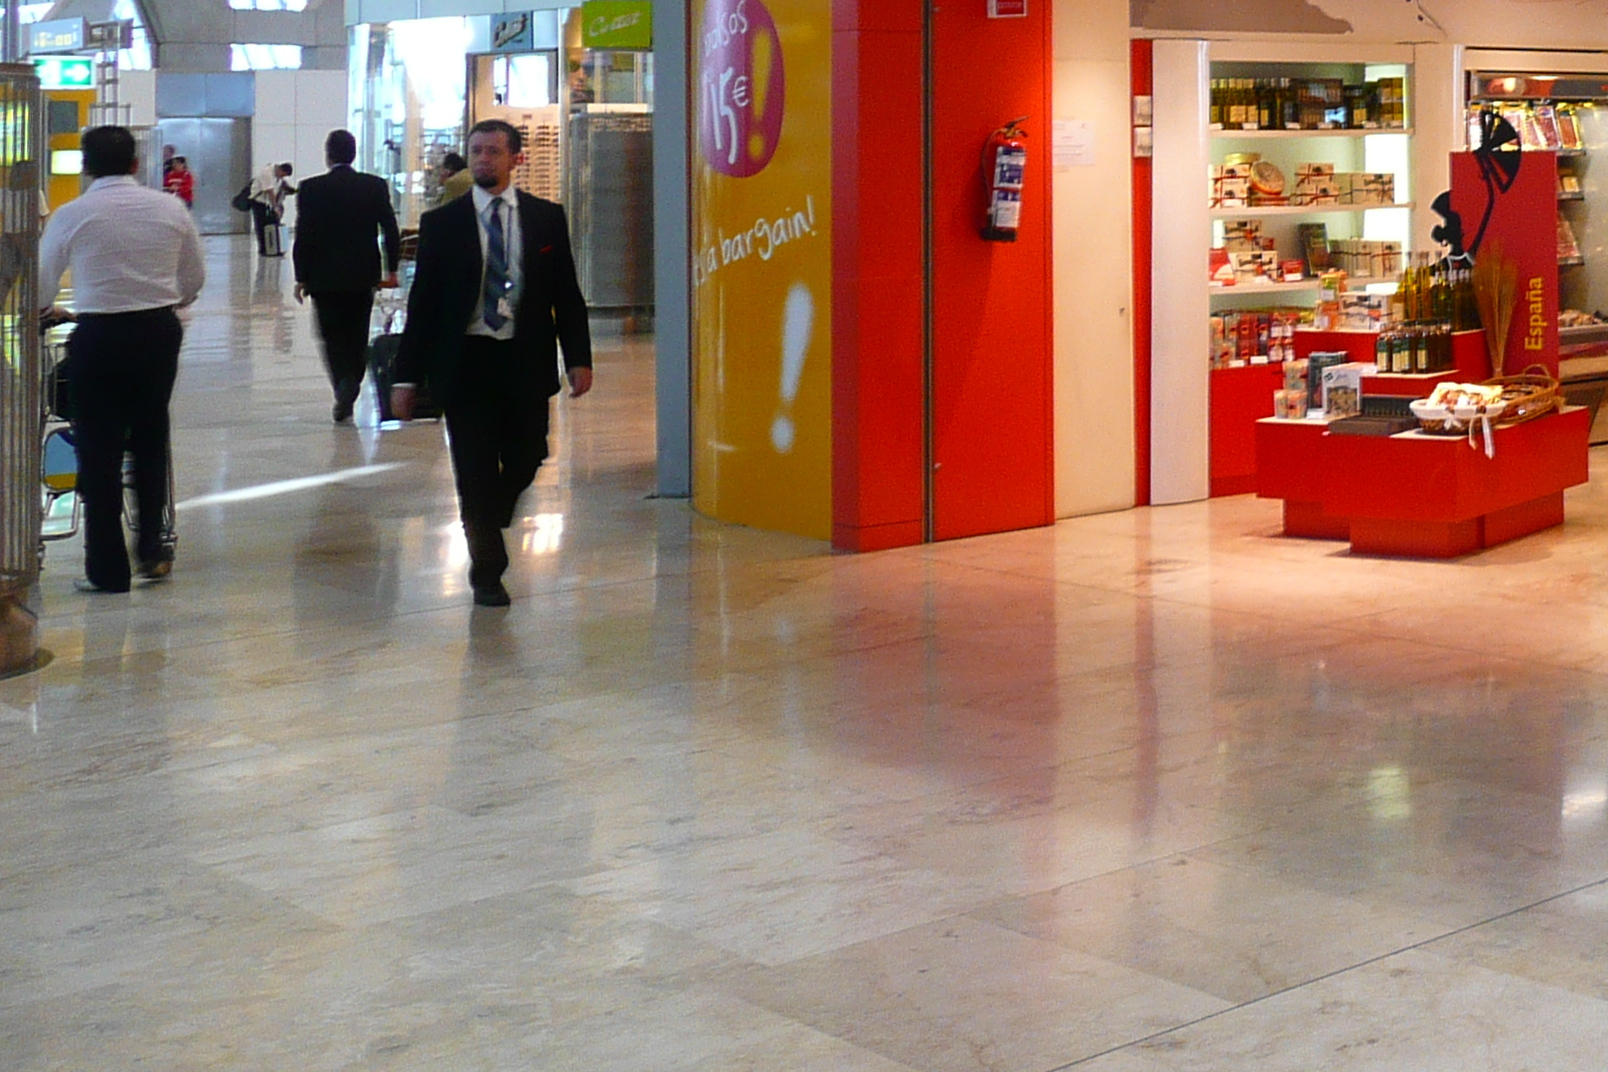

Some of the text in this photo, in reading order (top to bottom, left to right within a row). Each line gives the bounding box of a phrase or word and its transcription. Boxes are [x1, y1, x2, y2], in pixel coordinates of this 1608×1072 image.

[707, 246, 719, 274] a
[718, 194, 818, 266] bargain!
[1524, 277, 1548, 351] España
